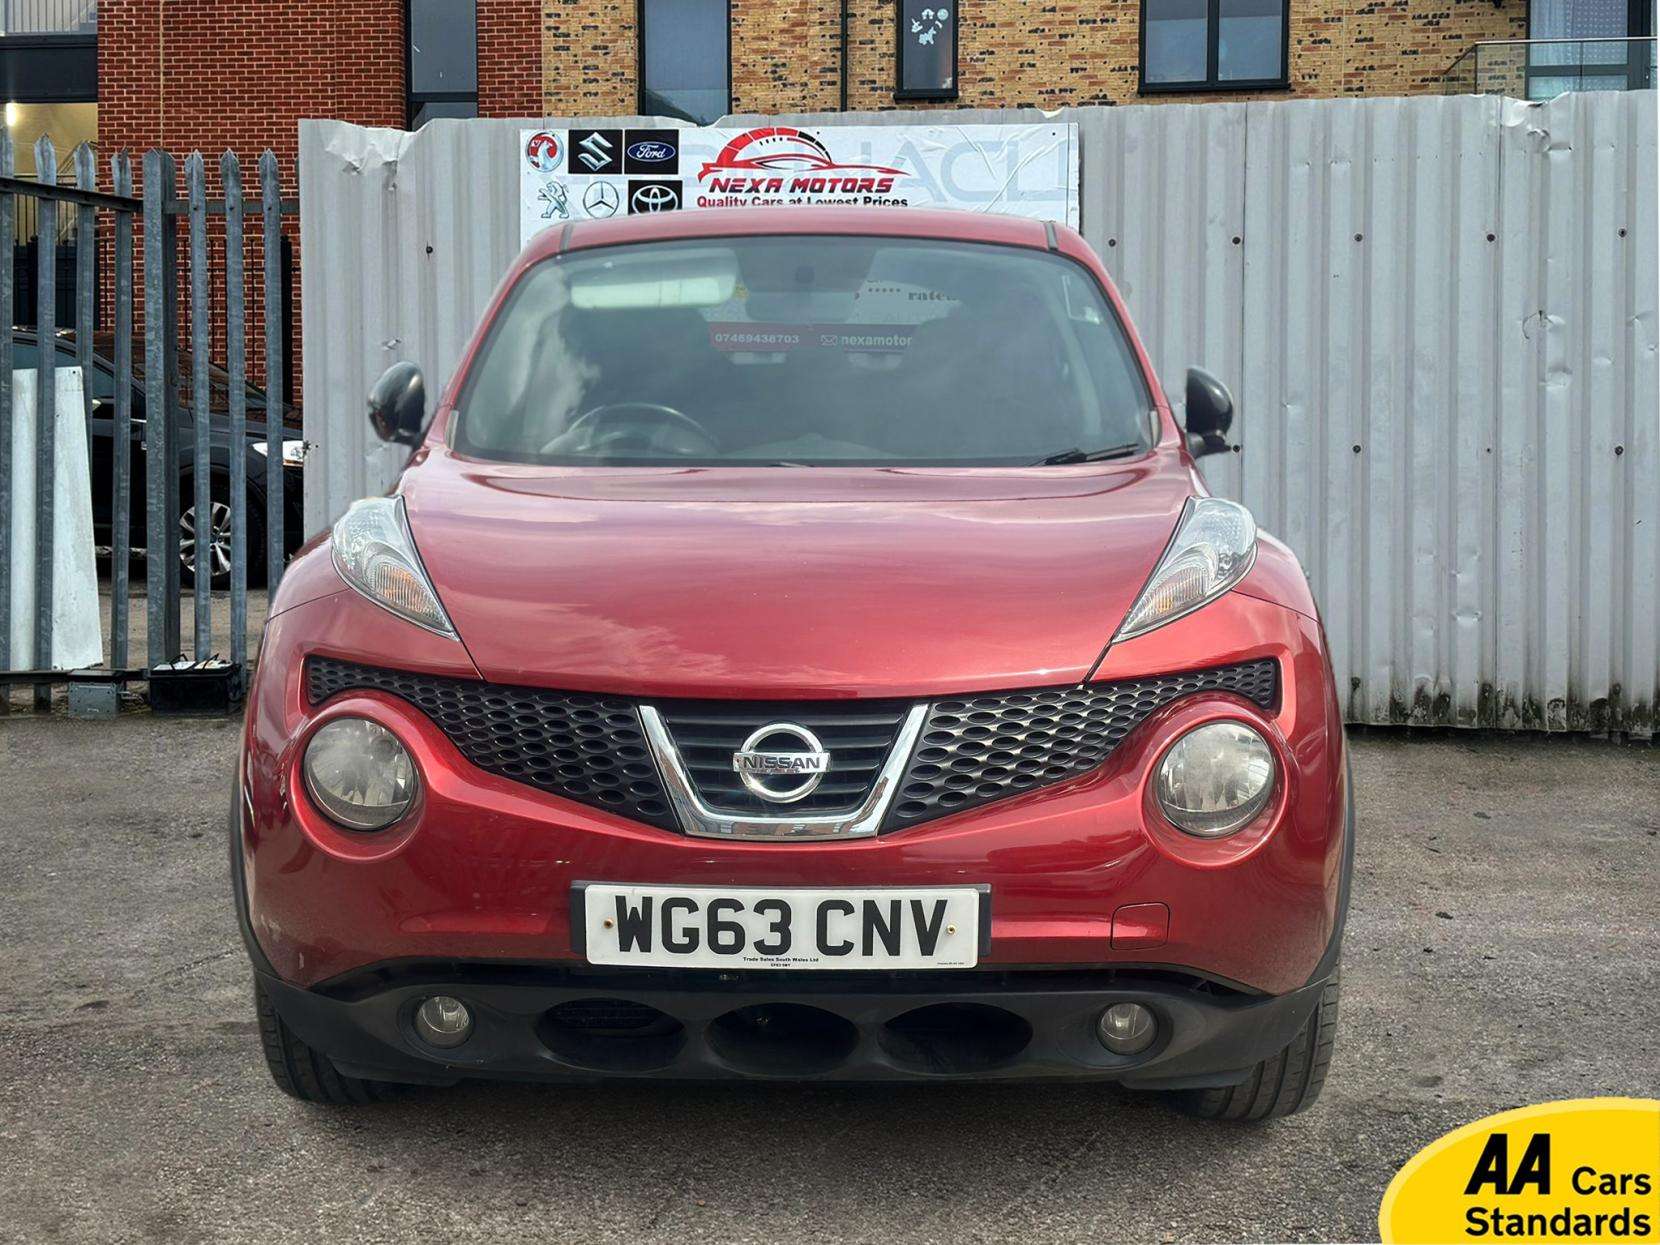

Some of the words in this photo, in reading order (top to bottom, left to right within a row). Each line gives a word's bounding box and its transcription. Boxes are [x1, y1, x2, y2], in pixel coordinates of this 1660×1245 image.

[636, 144, 666, 159] Ford
[708, 177, 783, 194] NEXA
[789, 177, 895, 194] MOTORS
[697, 196, 747, 208] Quality
[751, 196, 783, 207] Cars
[806, 196, 860, 206] Lowest
[863, 196, 909, 208] Prices
[743, 756, 820, 769] NISSAN
[614, 895, 792, 956] WG63
[815, 899, 949, 957] CNV
